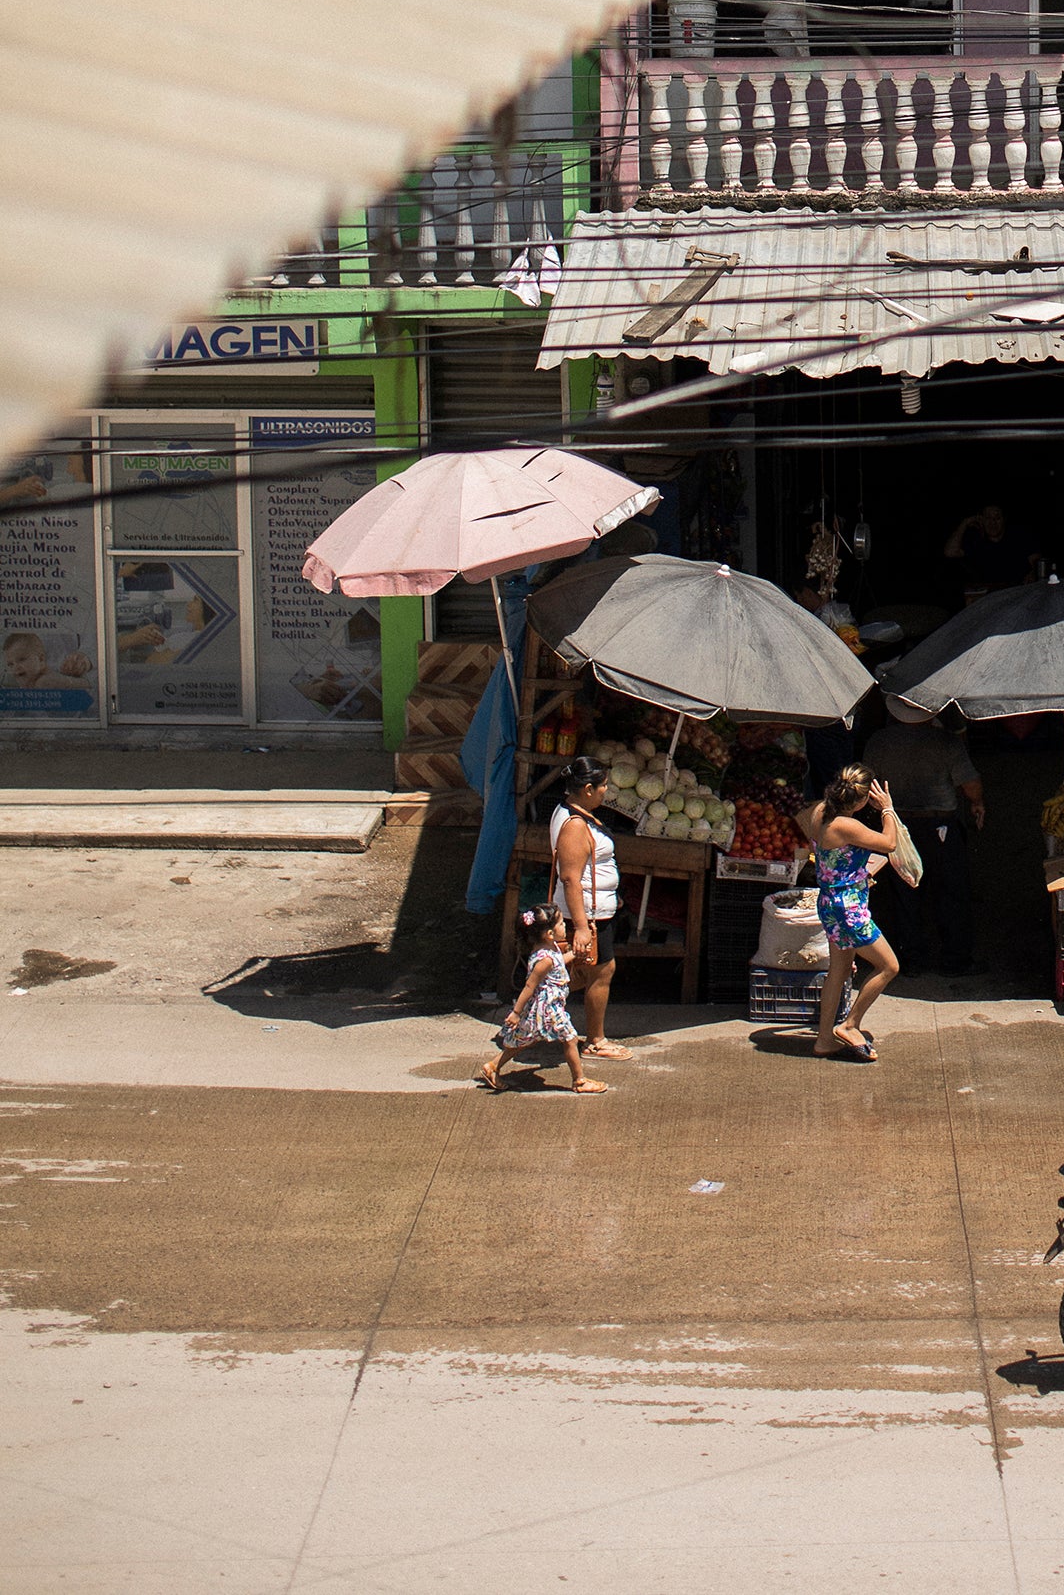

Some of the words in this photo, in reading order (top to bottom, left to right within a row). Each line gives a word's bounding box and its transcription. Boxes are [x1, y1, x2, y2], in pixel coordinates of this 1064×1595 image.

[260, 421, 372, 434] ULTRASONIDOS
[267, 485, 319, 495] Completo
[268, 496, 316, 505] Abdomen
[41, 517, 79, 527] Niños
[7, 529, 60, 540] Adultos
[174, 533, 229, 541] Ultrasonidos
[268, 529, 309, 538] Pélvico
[34, 542, 77, 553] Menor
[269, 541, 307, 551] Vaginal
[52, 568, 66, 578] de
[271, 597, 324, 606] Testicular
[271, 609, 306, 617] Partes
[311, 608, 353, 617] Blandas
[4, 618, 57, 629] Familiar
[272, 620, 320, 628] Hombros
[272, 631, 317, 640] Rodillas
